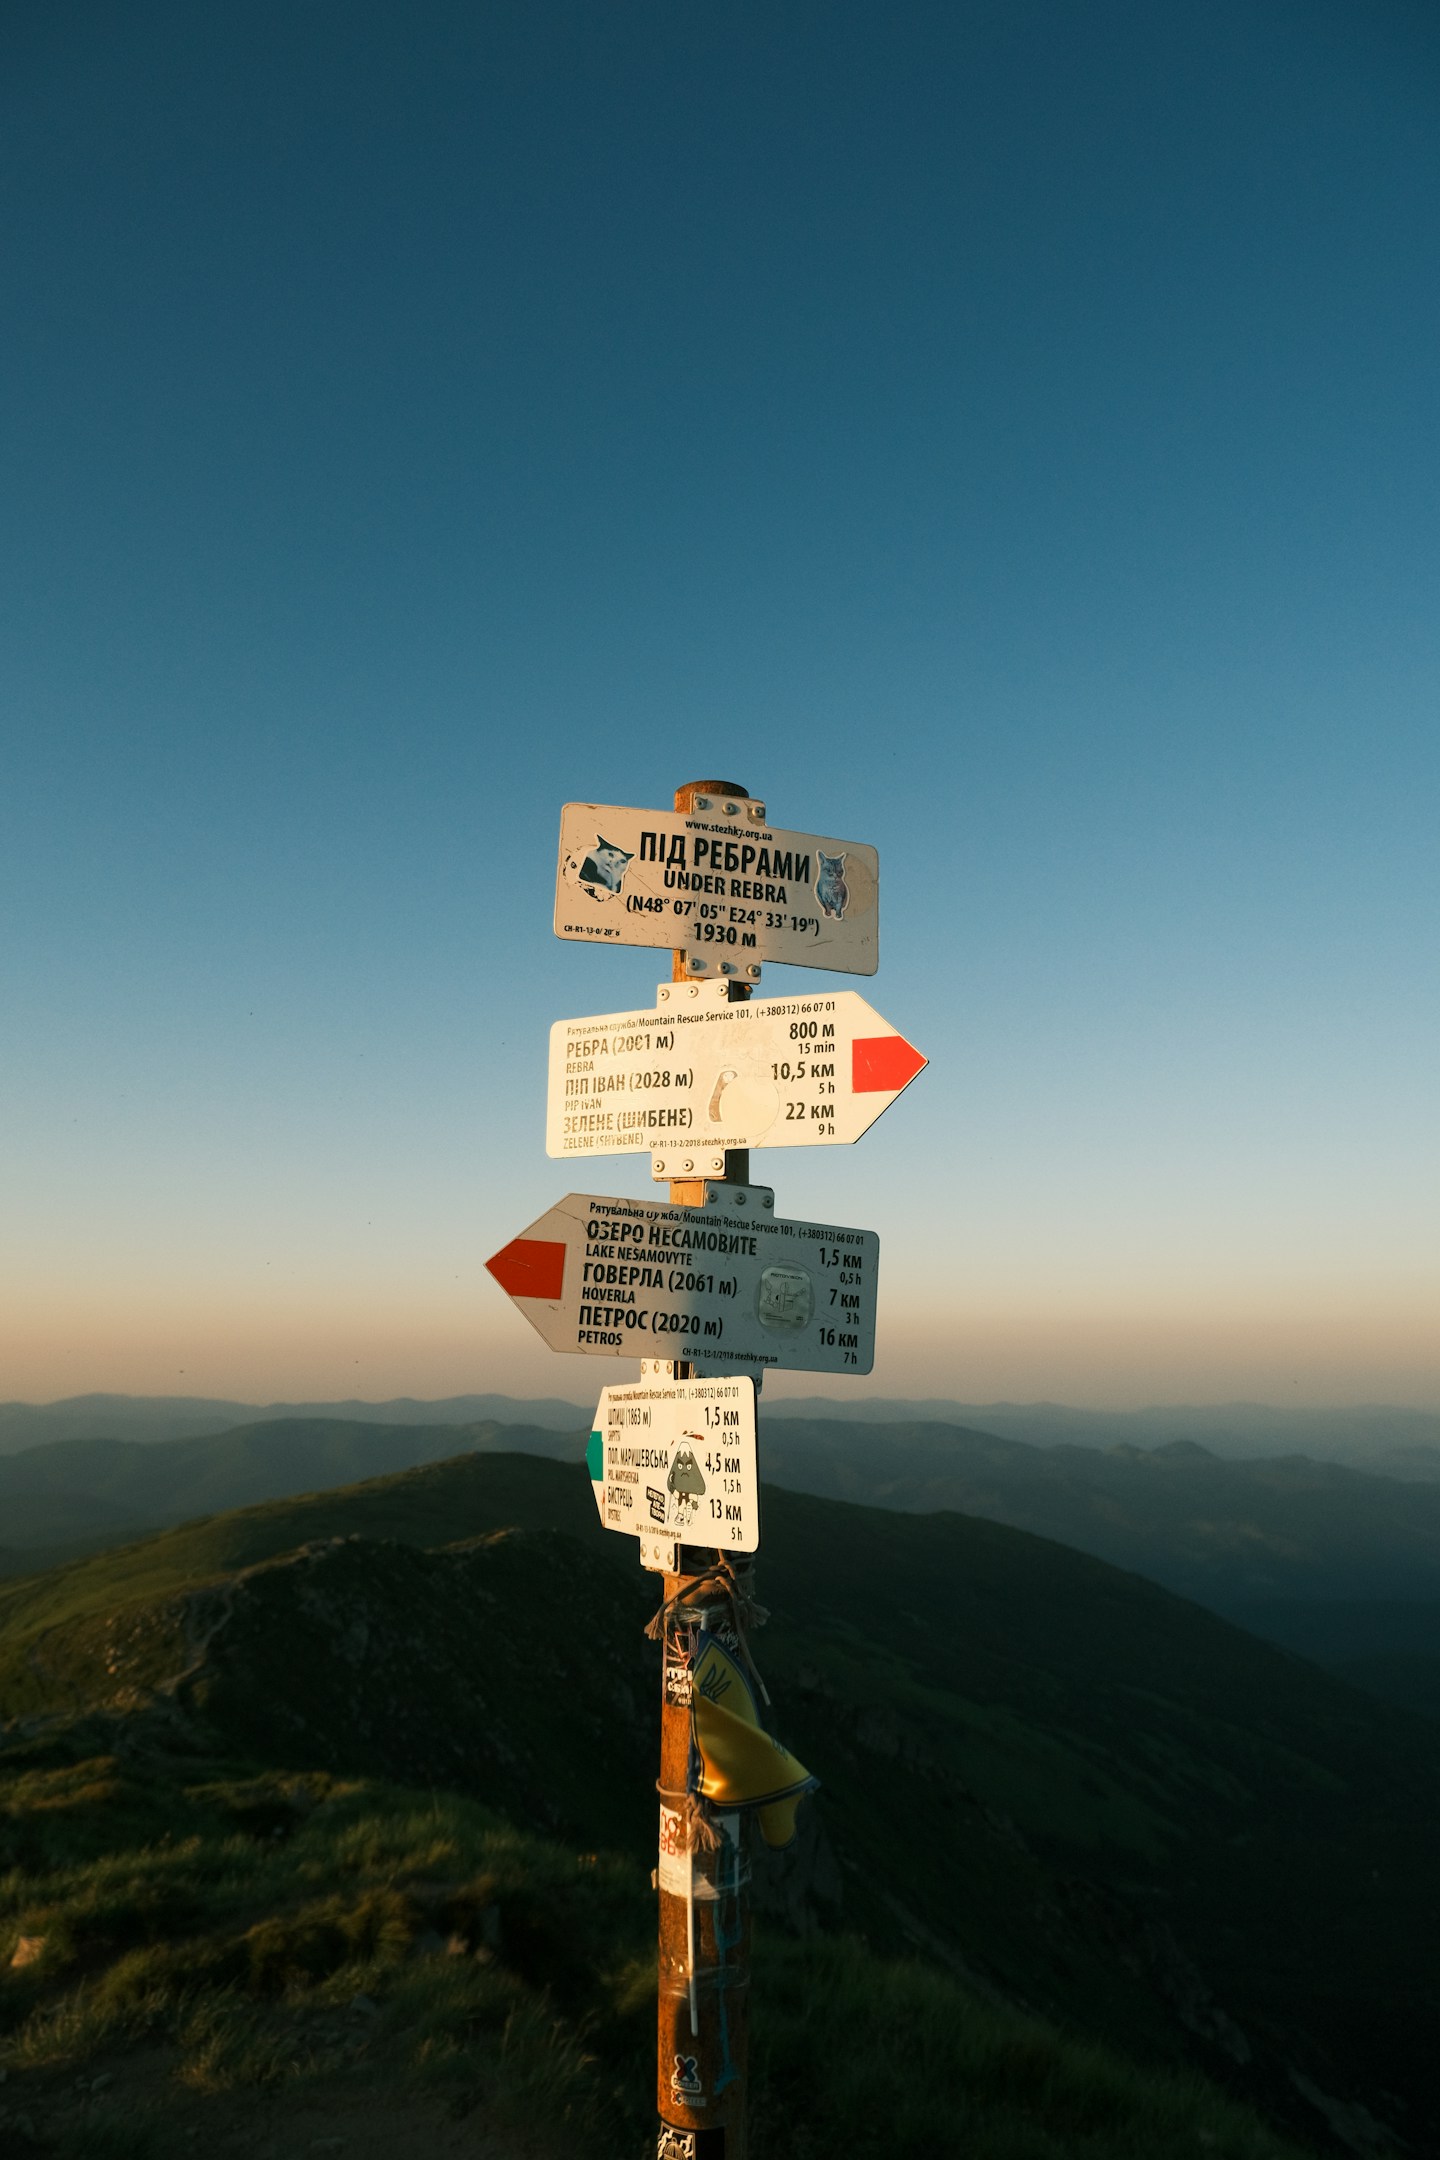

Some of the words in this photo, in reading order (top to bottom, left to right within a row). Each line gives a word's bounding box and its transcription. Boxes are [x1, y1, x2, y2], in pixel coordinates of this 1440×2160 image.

[685, 821, 773, 841] www.stezhky.org.ua
[640, 832, 686, 870] ПІД
[694, 838, 810, 883] РЕБРАМИ
[664, 870, 726, 895] UNDER
[731, 879, 787, 904] REBRA
[627, 895, 670, 913] (N48°
[673, 900, 696, 916] 07'
[730, 907, 762, 925] E24°
[766, 912, 787, 928] 33'
[694, 923, 737, 945] 1930
[677, 1013, 704, 1024] Rescue
[705, 1010, 734, 1022] Service
[736, 1009, 753, 1020] 101,
[756, 1004, 800, 1018] (+380312)
[801, 1003, 812, 1013] 66
[813, 1002, 824, 1012] 07
[825, 1001, 836, 1011] 01
[789, 1021, 818, 1040] 800
[567, 1038, 609, 1059] РЕБРА
[656, 1031, 675, 1051] м)
[798, 1043, 811, 1055] 15
[814, 1041, 835, 1053] min
[772, 1061, 806, 1082] 10,5
[565, 1078, 589, 1096] ПІП
[592, 1074, 626, 1094] ІВАН
[629, 1071, 671, 1092] (2028
[674, 1068, 694, 1089] м)
[818, 1083, 825, 1094] 5
[828, 1081, 835, 1094] h
[785, 1102, 805, 1120] 22
[563, 1113, 614, 1134] ЗЕЛЕНЕ
[617, 1108, 693, 1132] (ШИБЕНЕ)
[818, 1124, 825, 1135] 9
[828, 1123, 835, 1135] h
[563, 1136, 594, 1150] ZELENE
[701, 1138, 747, 1147] stezhky.org.ua
[589, 1202, 644, 1218] Рятувальна
[723, 1217, 750, 1230] Rescue
[751, 1221, 778, 1234] Service
[780, 1225, 796, 1237] 101,
[798, 1227, 836, 1243] (+380312)
[836, 1233, 845, 1243] 66
[846, 1234, 855, 1244] 07
[856, 1235, 864, 1245] 01
[587, 1219, 644, 1243] ОЗЕРО
[648, 1226, 757, 1256] НЕСАМОВИТЕ
[586, 1243, 614, 1259] LAKE
[617, 1246, 693, 1266] NESAMOVYTE
[819, 1247, 840, 1268] 1,5
[583, 1262, 664, 1289] ГОВЕРЛА
[668, 1270, 714, 1293] (2061
[719, 1276, 738, 1299] м)
[839, 1271, 854, 1285] 0,5
[856, 1272, 861, 1285] h
[582, 1286, 636, 1304] HOVERLA
[829, 1288, 838, 1306] 7
[579, 1305, 648, 1330] ПЕТРОС
[652, 1311, 701, 1334] (2020
[703, 1317, 723, 1339] м)
[846, 1312, 852, 1324] 3
[853, 1312, 860, 1325] h
[578, 1330, 623, 1346] PETROS
[819, 1327, 836, 1346] 16
[734, 1353, 778, 1365] stezhky.org.ua
[844, 1352, 850, 1364] 7
[851, 1352, 857, 1365] h
[688, 1387, 716, 1400] (+380312)
[716, 1387, 723, 1398] 66
[724, 1386, 731, 1398] 07
[732, 1386, 739, 1398] 01
[704, 1406, 720, 1429] 1,5
[722, 1431, 734, 1447] 0,5
[735, 1431, 740, 1445] h
[705, 1452, 722, 1475] 4,5
[723, 1478, 735, 1494] 1,5
[736, 1479, 742, 1493] h
[709, 1498, 722, 1519] 13
[731, 1527, 736, 1540] 5
[737, 1526, 743, 1541] h
